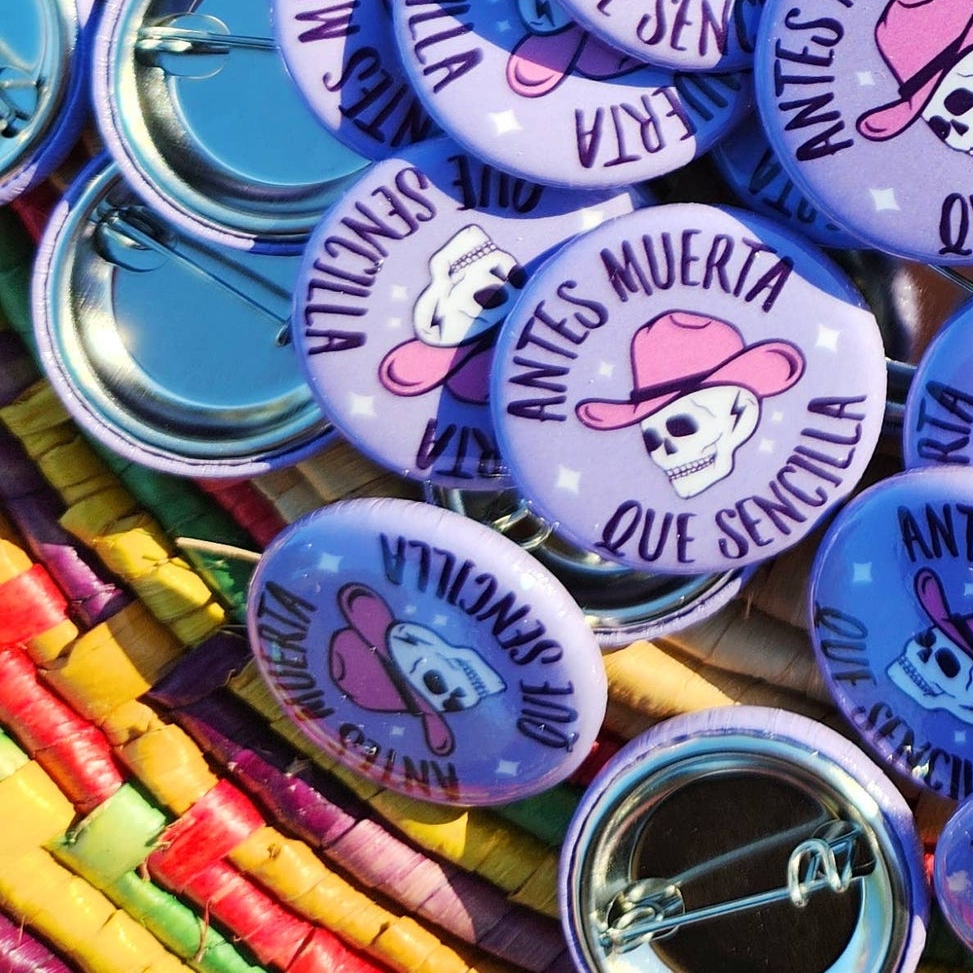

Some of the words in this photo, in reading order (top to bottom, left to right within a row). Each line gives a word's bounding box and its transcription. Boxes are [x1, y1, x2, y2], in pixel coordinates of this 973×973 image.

[322, 46, 438, 147] NTES
[774, 7, 854, 161] ANTES
[305, 166, 437, 356] SENCILLA
[507, 279, 609, 422] ANTES
[599, 228, 794, 314] MUERTA
[593, 499, 698, 564] QUE
[714, 394, 868, 560] SENCILLA
[379, 532, 563, 667] SENCILLA
[815, 603, 877, 687] QUE
[515, 679, 580, 753] QUE
